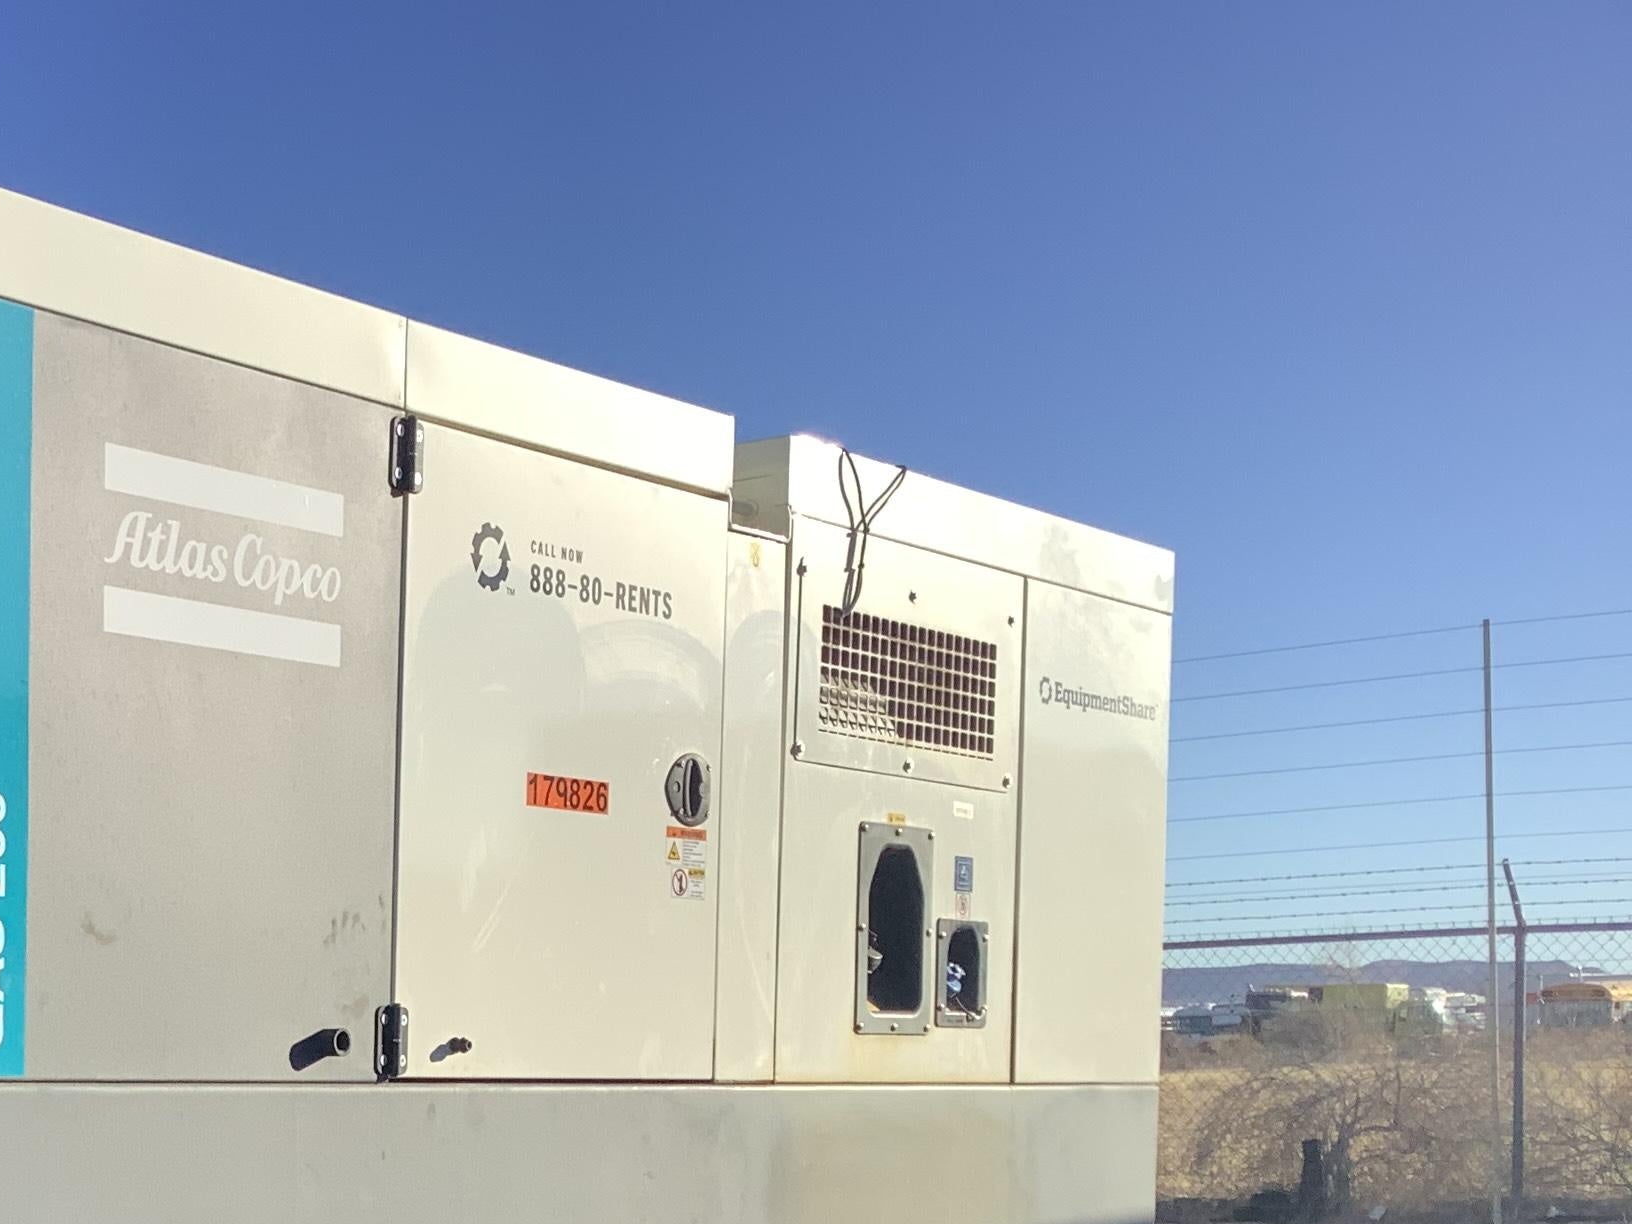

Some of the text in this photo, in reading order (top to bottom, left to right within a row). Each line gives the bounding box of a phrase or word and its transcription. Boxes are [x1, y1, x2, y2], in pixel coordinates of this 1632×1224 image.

[103, 510, 341, 606] Atlas Copco
[530, 540, 583, 564] CALL NOW
[529, 563, 673, 620] 888-80-RENTS
[1054, 681, 1156, 721] EquipmentShare
[528, 774, 608, 813] 179826
